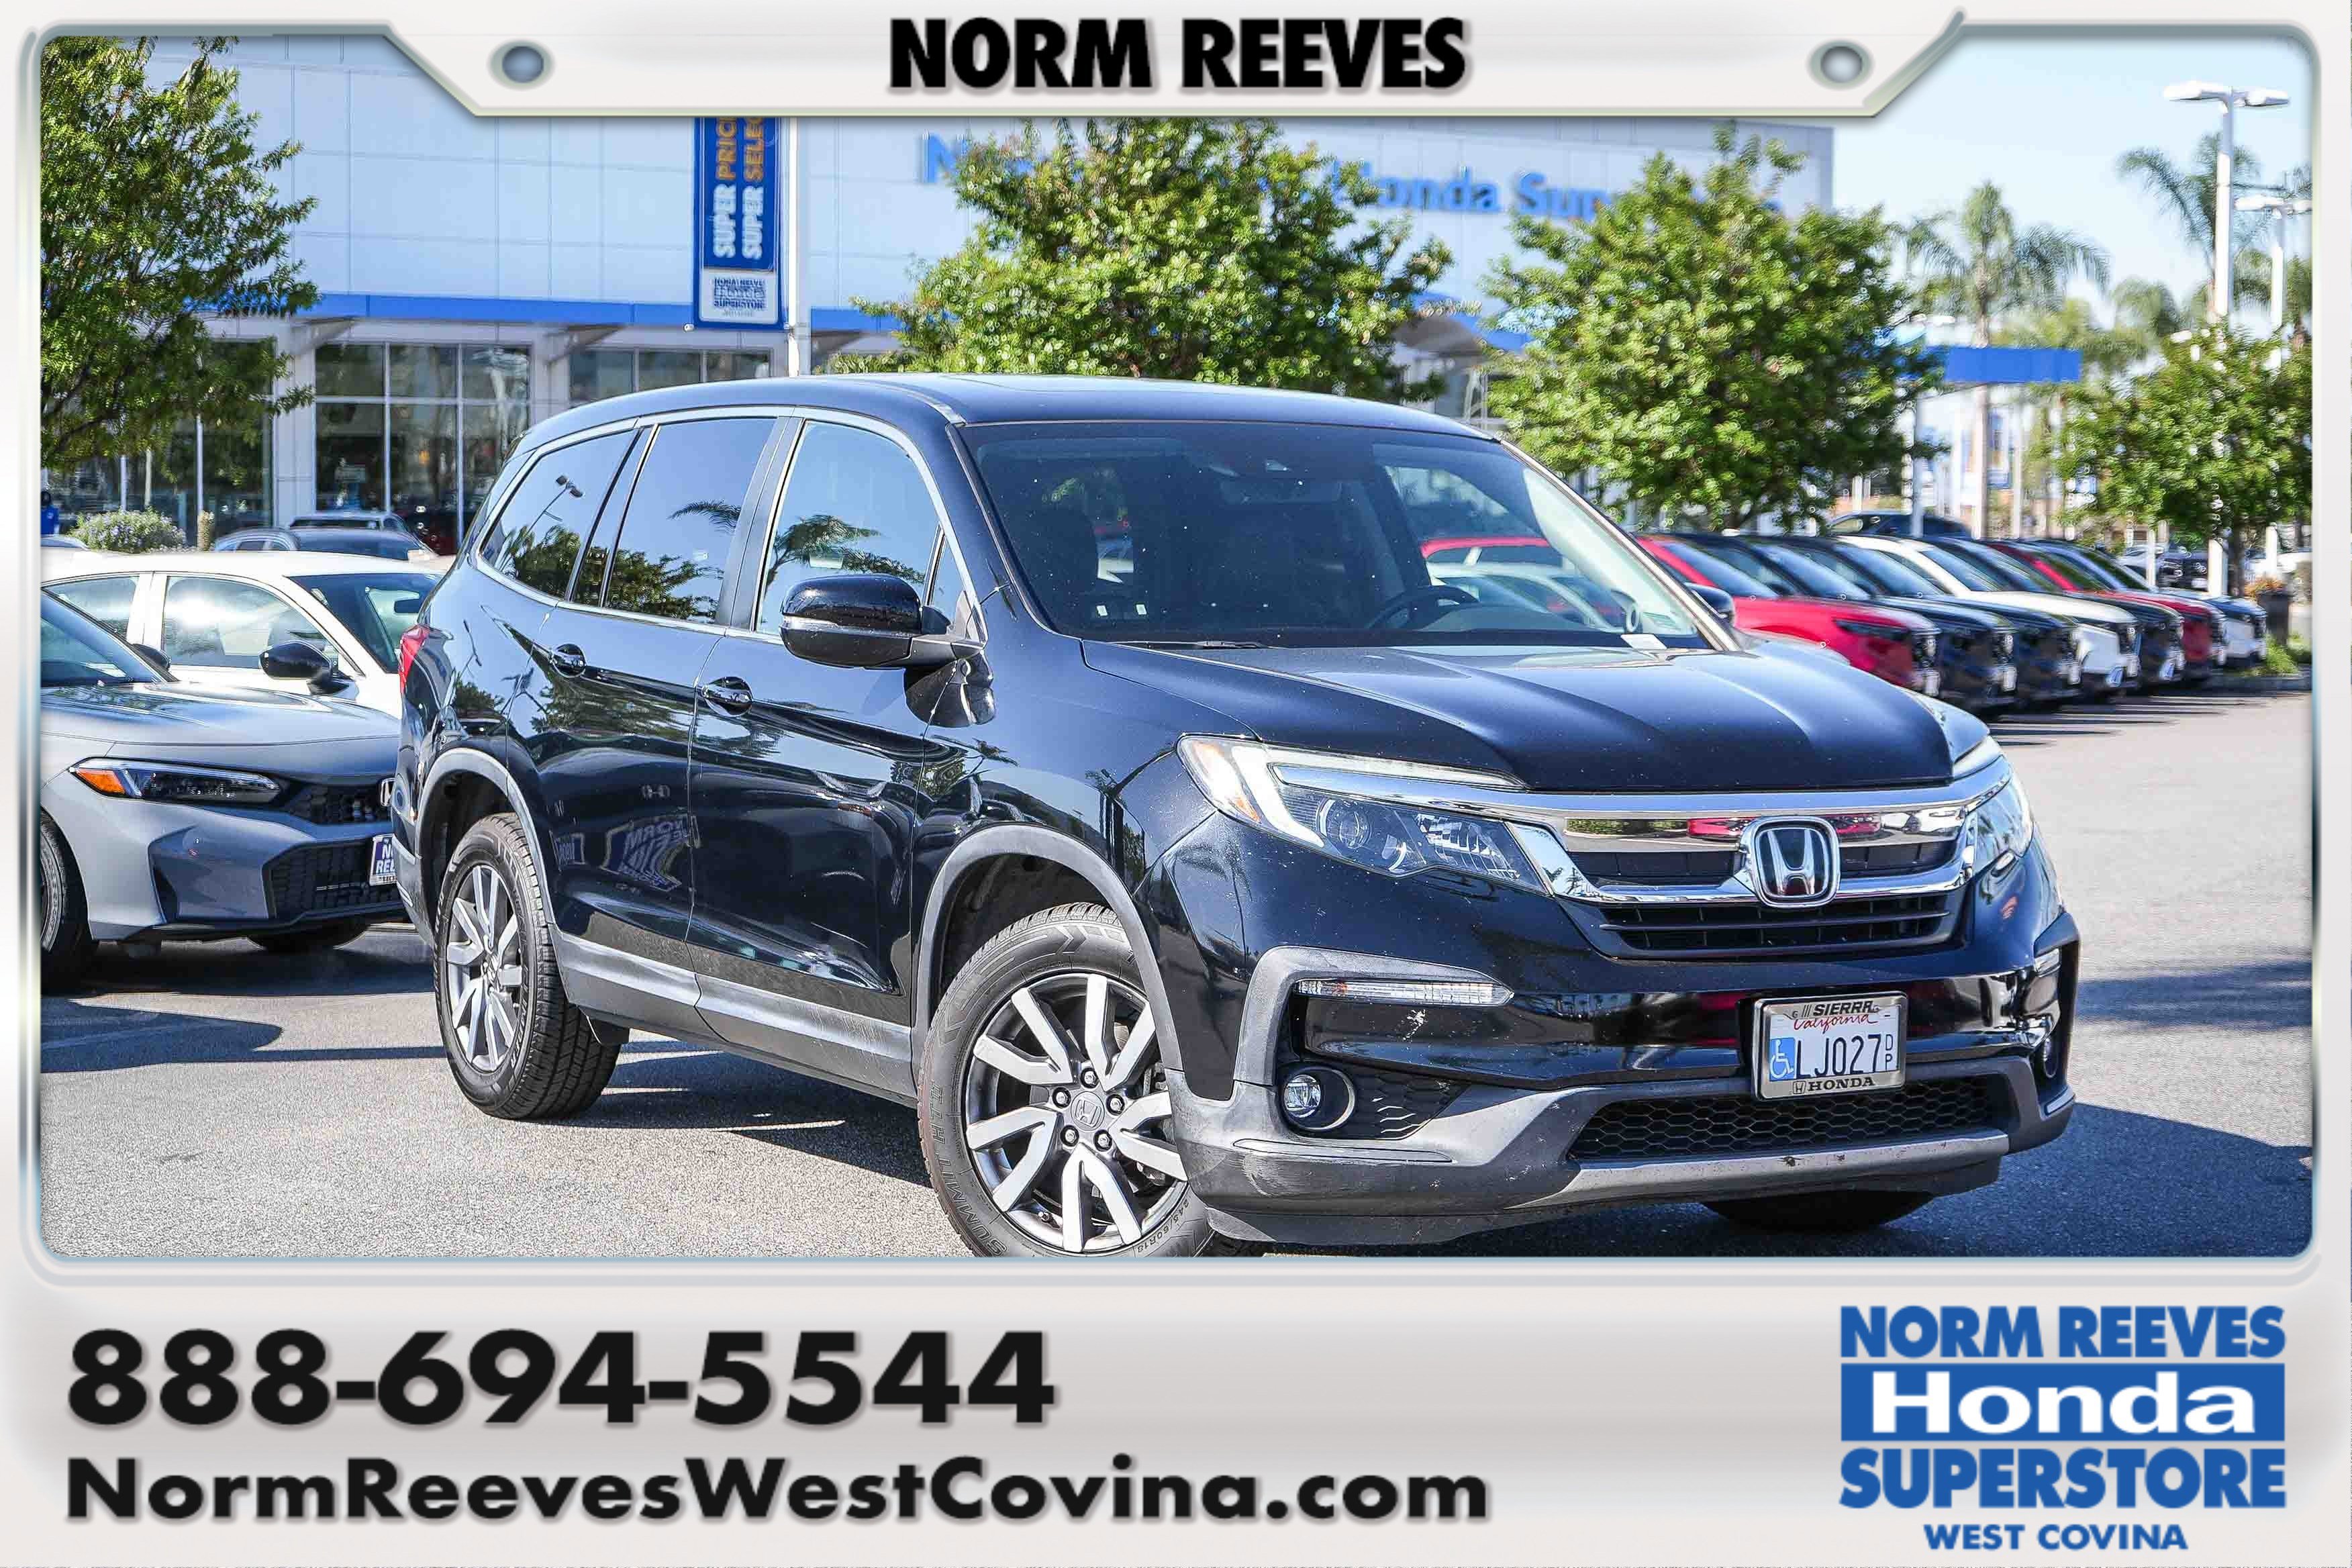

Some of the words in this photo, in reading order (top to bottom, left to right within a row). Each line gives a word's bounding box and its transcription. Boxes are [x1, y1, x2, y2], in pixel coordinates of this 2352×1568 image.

[716, 117, 737, 181] PRIC
[713, 183, 736, 258] SUPER
[742, 185, 764, 260] SUPER
[1812, 1000, 1875, 1017] SIERRA
[1795, 1034, 1881, 1079] LJ027
[1808, 1077, 1876, 1092] HONDA
[934, 1151, 1008, 1257] SUMMIT
